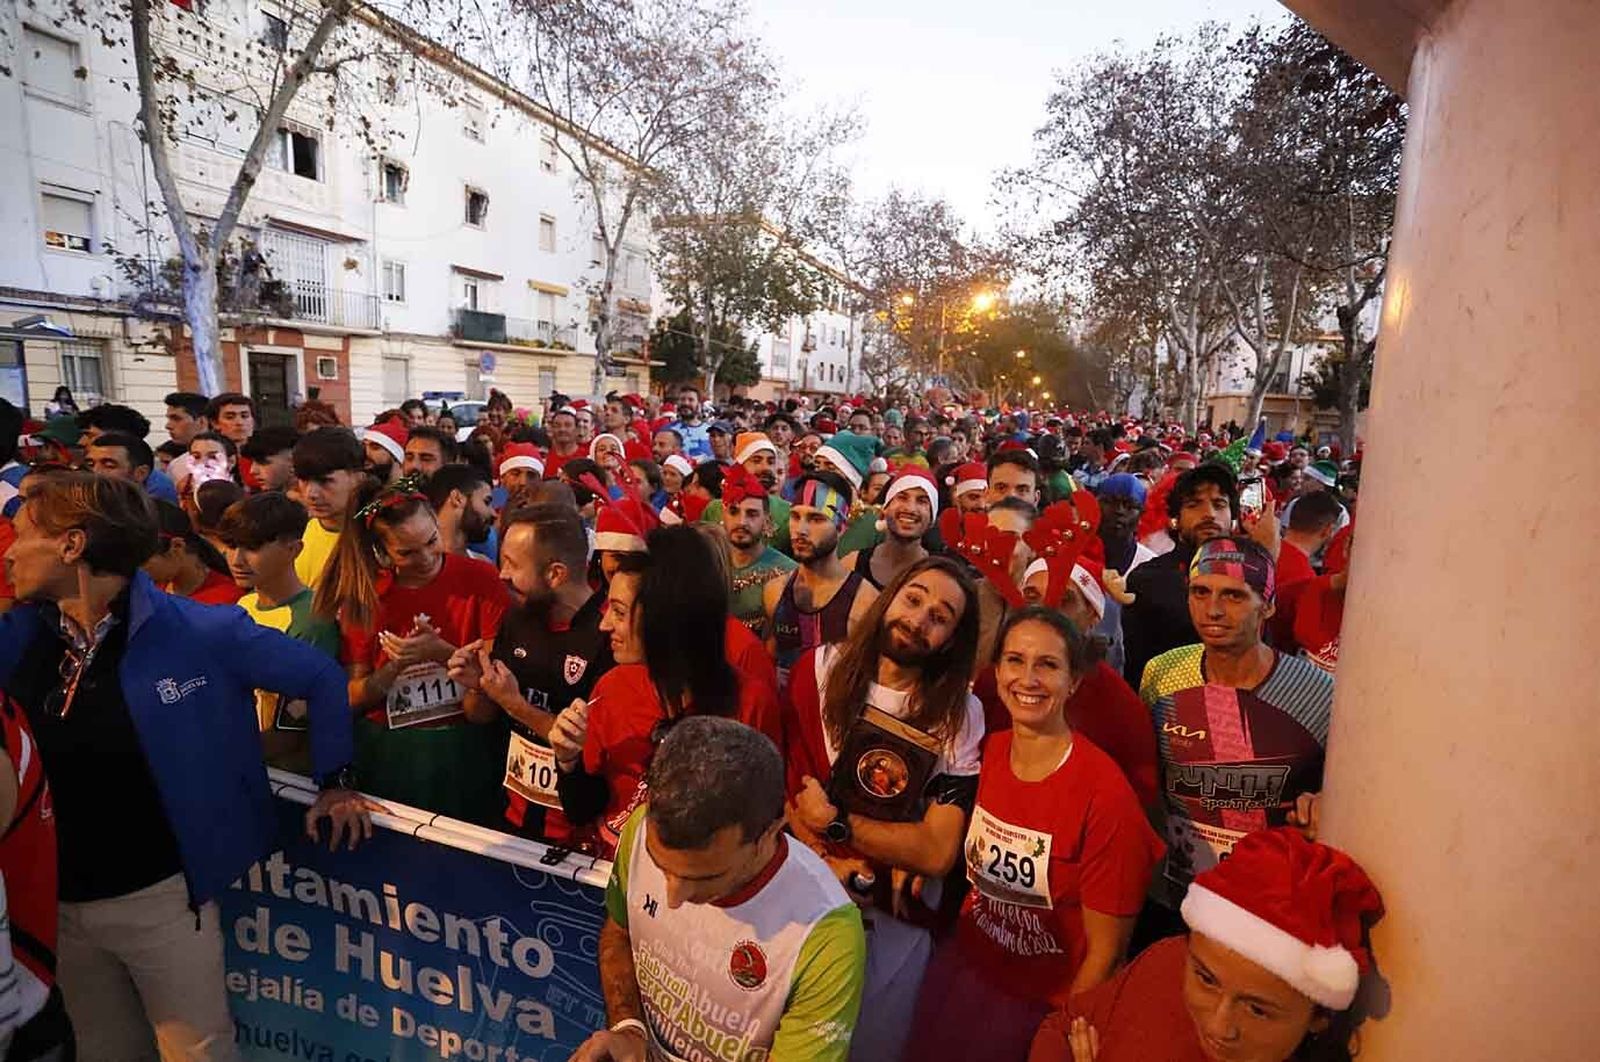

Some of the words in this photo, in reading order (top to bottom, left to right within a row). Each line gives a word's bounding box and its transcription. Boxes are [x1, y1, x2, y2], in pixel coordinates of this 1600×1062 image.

[417, 678, 457, 704] 111
[529, 761, 559, 789] 10
[987, 844, 1036, 888] 259
[234, 906, 312, 962] de
[335, 923, 557, 1041] Huelva
[335, 993, 380, 1028] de
[392, 1005, 541, 1062] Deport
